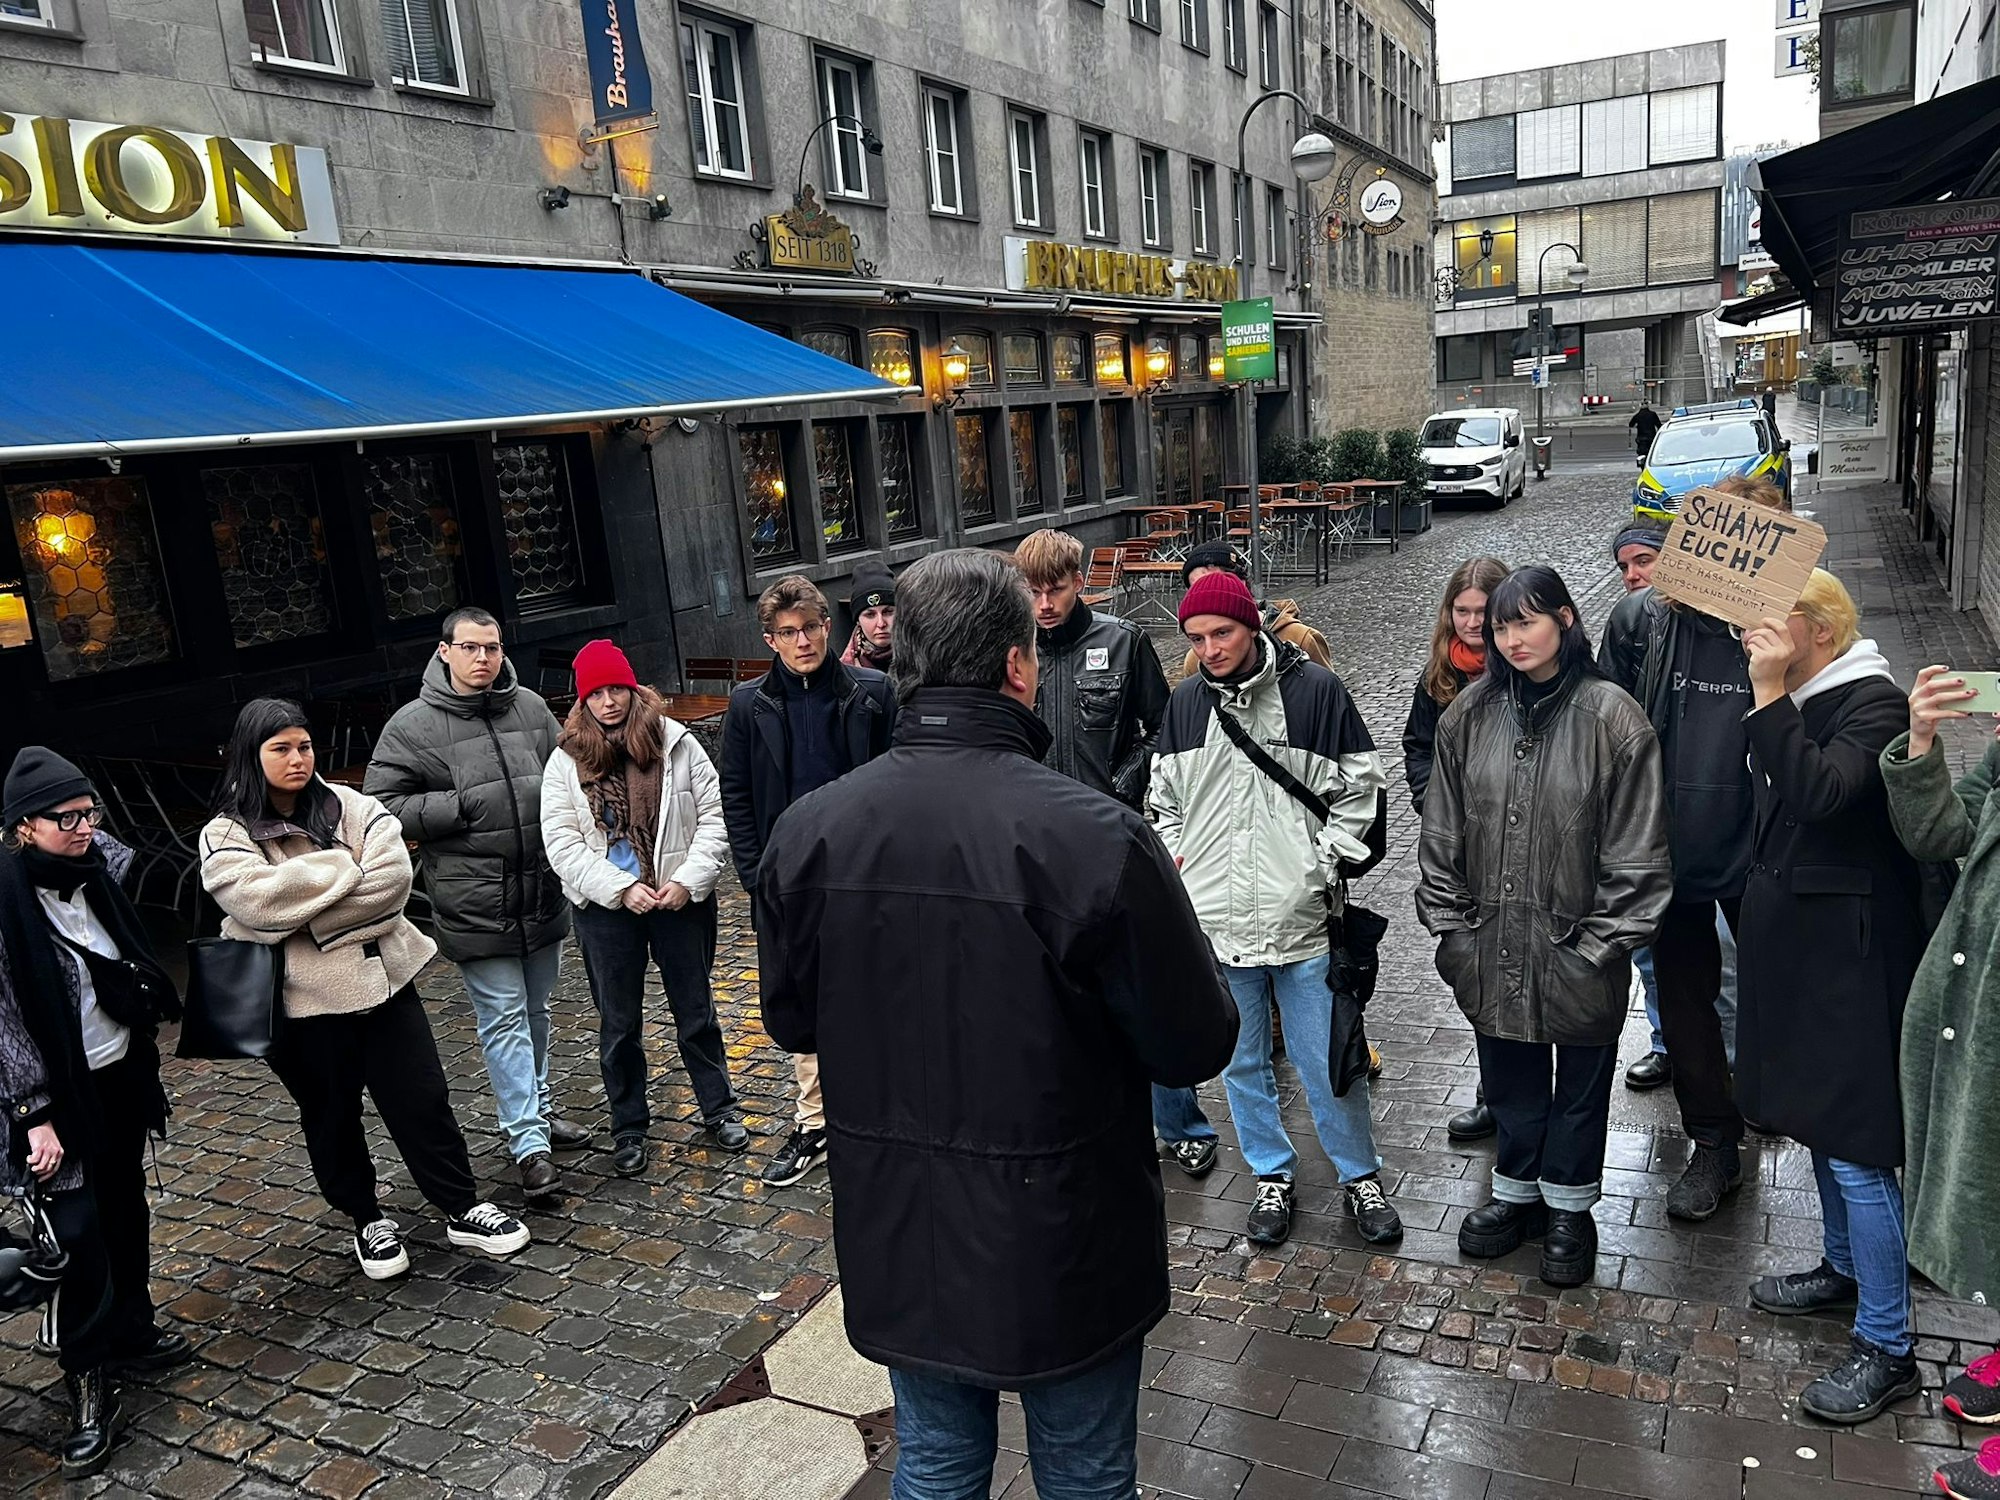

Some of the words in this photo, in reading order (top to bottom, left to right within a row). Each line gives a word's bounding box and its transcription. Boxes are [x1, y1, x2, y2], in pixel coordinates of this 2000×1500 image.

[1365, 192, 1397, 213] Sion
[1362, 219, 1402, 234] BRAUHAUS
[1859, 211, 1926, 232] KÖLN
[1930, 203, 2000, 224] GOLD
[1909, 229, 1934, 238] Like
[1944, 224, 1980, 234] PAWN
[777, 235, 811, 260] SEIT
[816, 240, 846, 263] 1318
[1841, 235, 1997, 265] UHREN
[1841, 275, 1996, 303] MÜNZEN
[1946, 287, 1988, 300] COINS
[1842, 300, 1994, 325] JUWELEN
[1225, 322, 1270, 338] SCHULEN
[1225, 337, 1242, 347] UND
[1243, 334, 1270, 345] KITAS:
[1226, 343, 1270, 357] SANIEREN!
[1839, 442, 1870, 452] Hotel
[1829, 464, 1877, 473] Museum
[1683, 495, 1797, 556] SCHÄMT
[1679, 529, 1766, 578] EUCH!
[1661, 553, 1693, 573] EUER
[1727, 578, 1758, 597] MACHT
